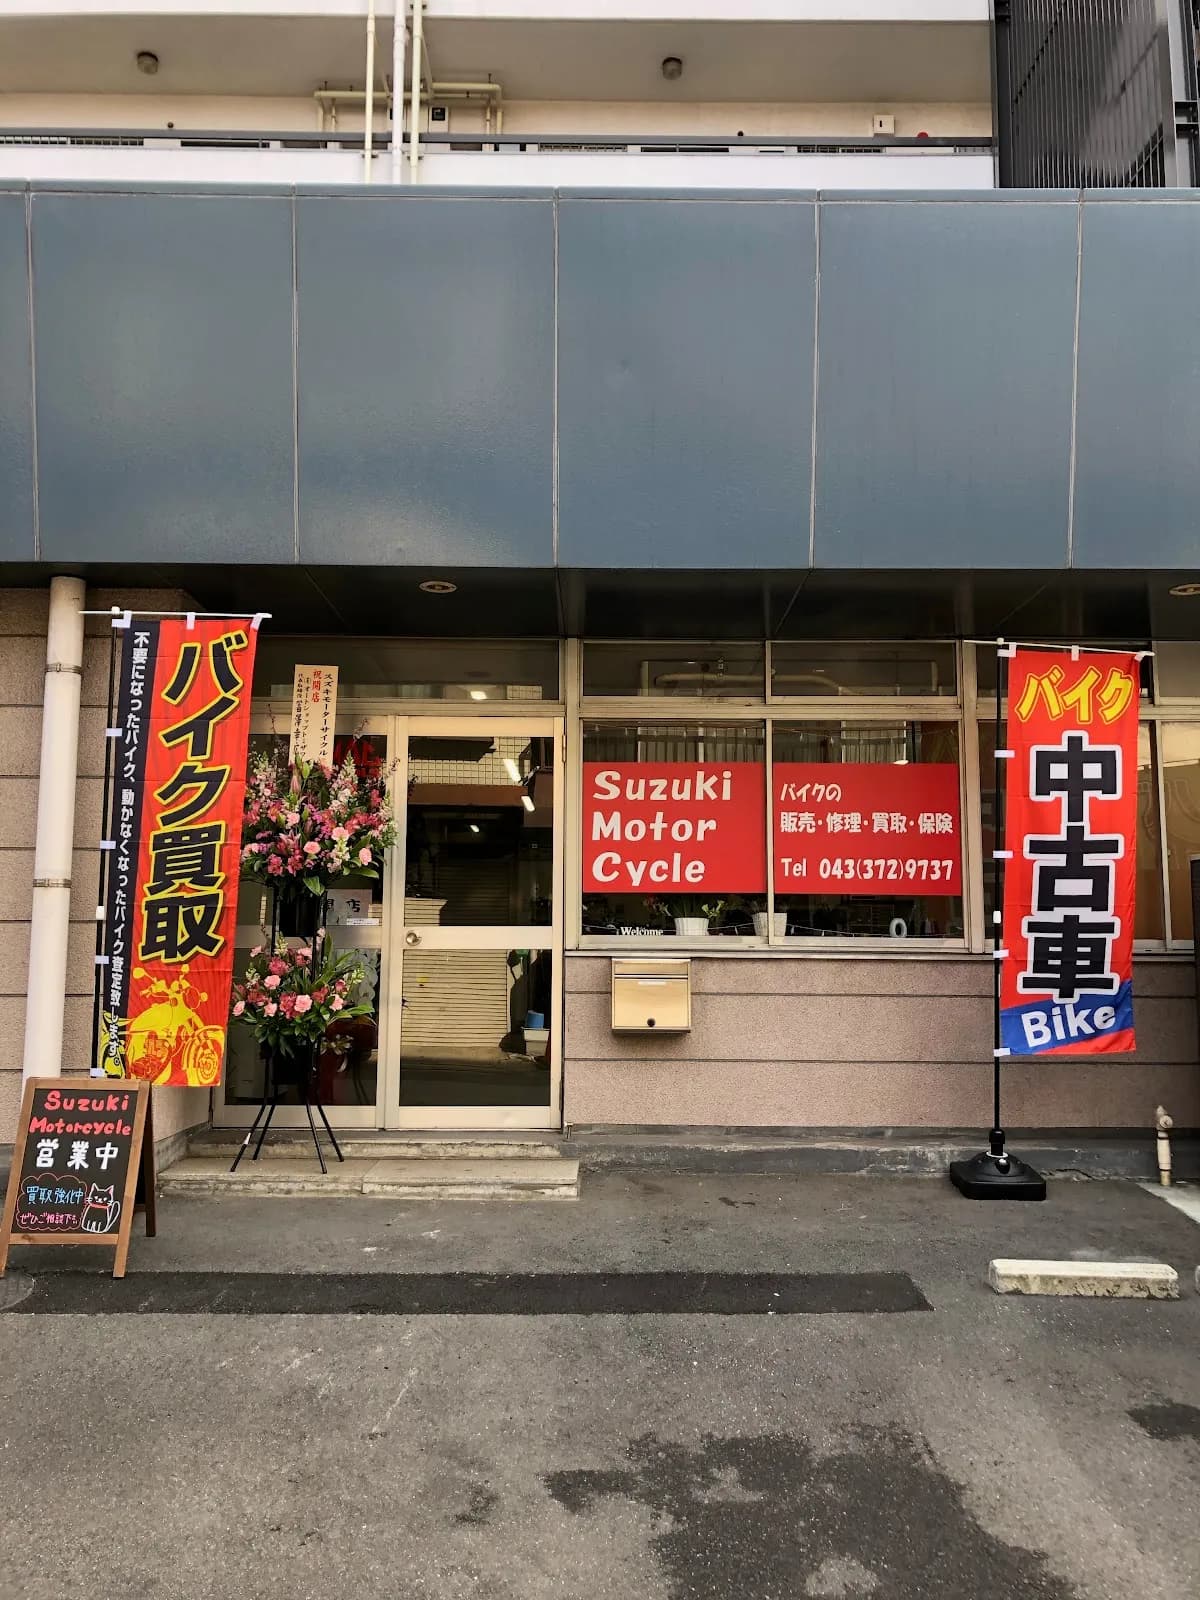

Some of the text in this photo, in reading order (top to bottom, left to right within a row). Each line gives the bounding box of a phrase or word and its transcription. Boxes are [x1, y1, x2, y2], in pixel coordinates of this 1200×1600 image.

[311, 670, 322, 703] 祝開店
[1015, 665, 1134, 724] バイク
[319, 673, 334, 756] スズキモーターサイクル
[138, 630, 248, 963] バイク買取
[593, 770, 732, 801] Suzuki
[780, 783, 842, 803] バイクの
[591, 811, 717, 841] Motor
[780, 811, 954, 834] 販売・修理・買取・保険
[592, 851, 705, 887] Cycle
[781, 858, 953, 881] Tel 043(372)9737
[1017, 730, 1123, 1005] 中古車
[620, 926, 664, 936] Welcome
[1020, 1003, 1117, 1048] Bike
[44, 1090, 129, 1112] Suzuki
[29, 1116, 132, 1136] Motorcycle
[36, 1138, 119, 1170] 営業中
